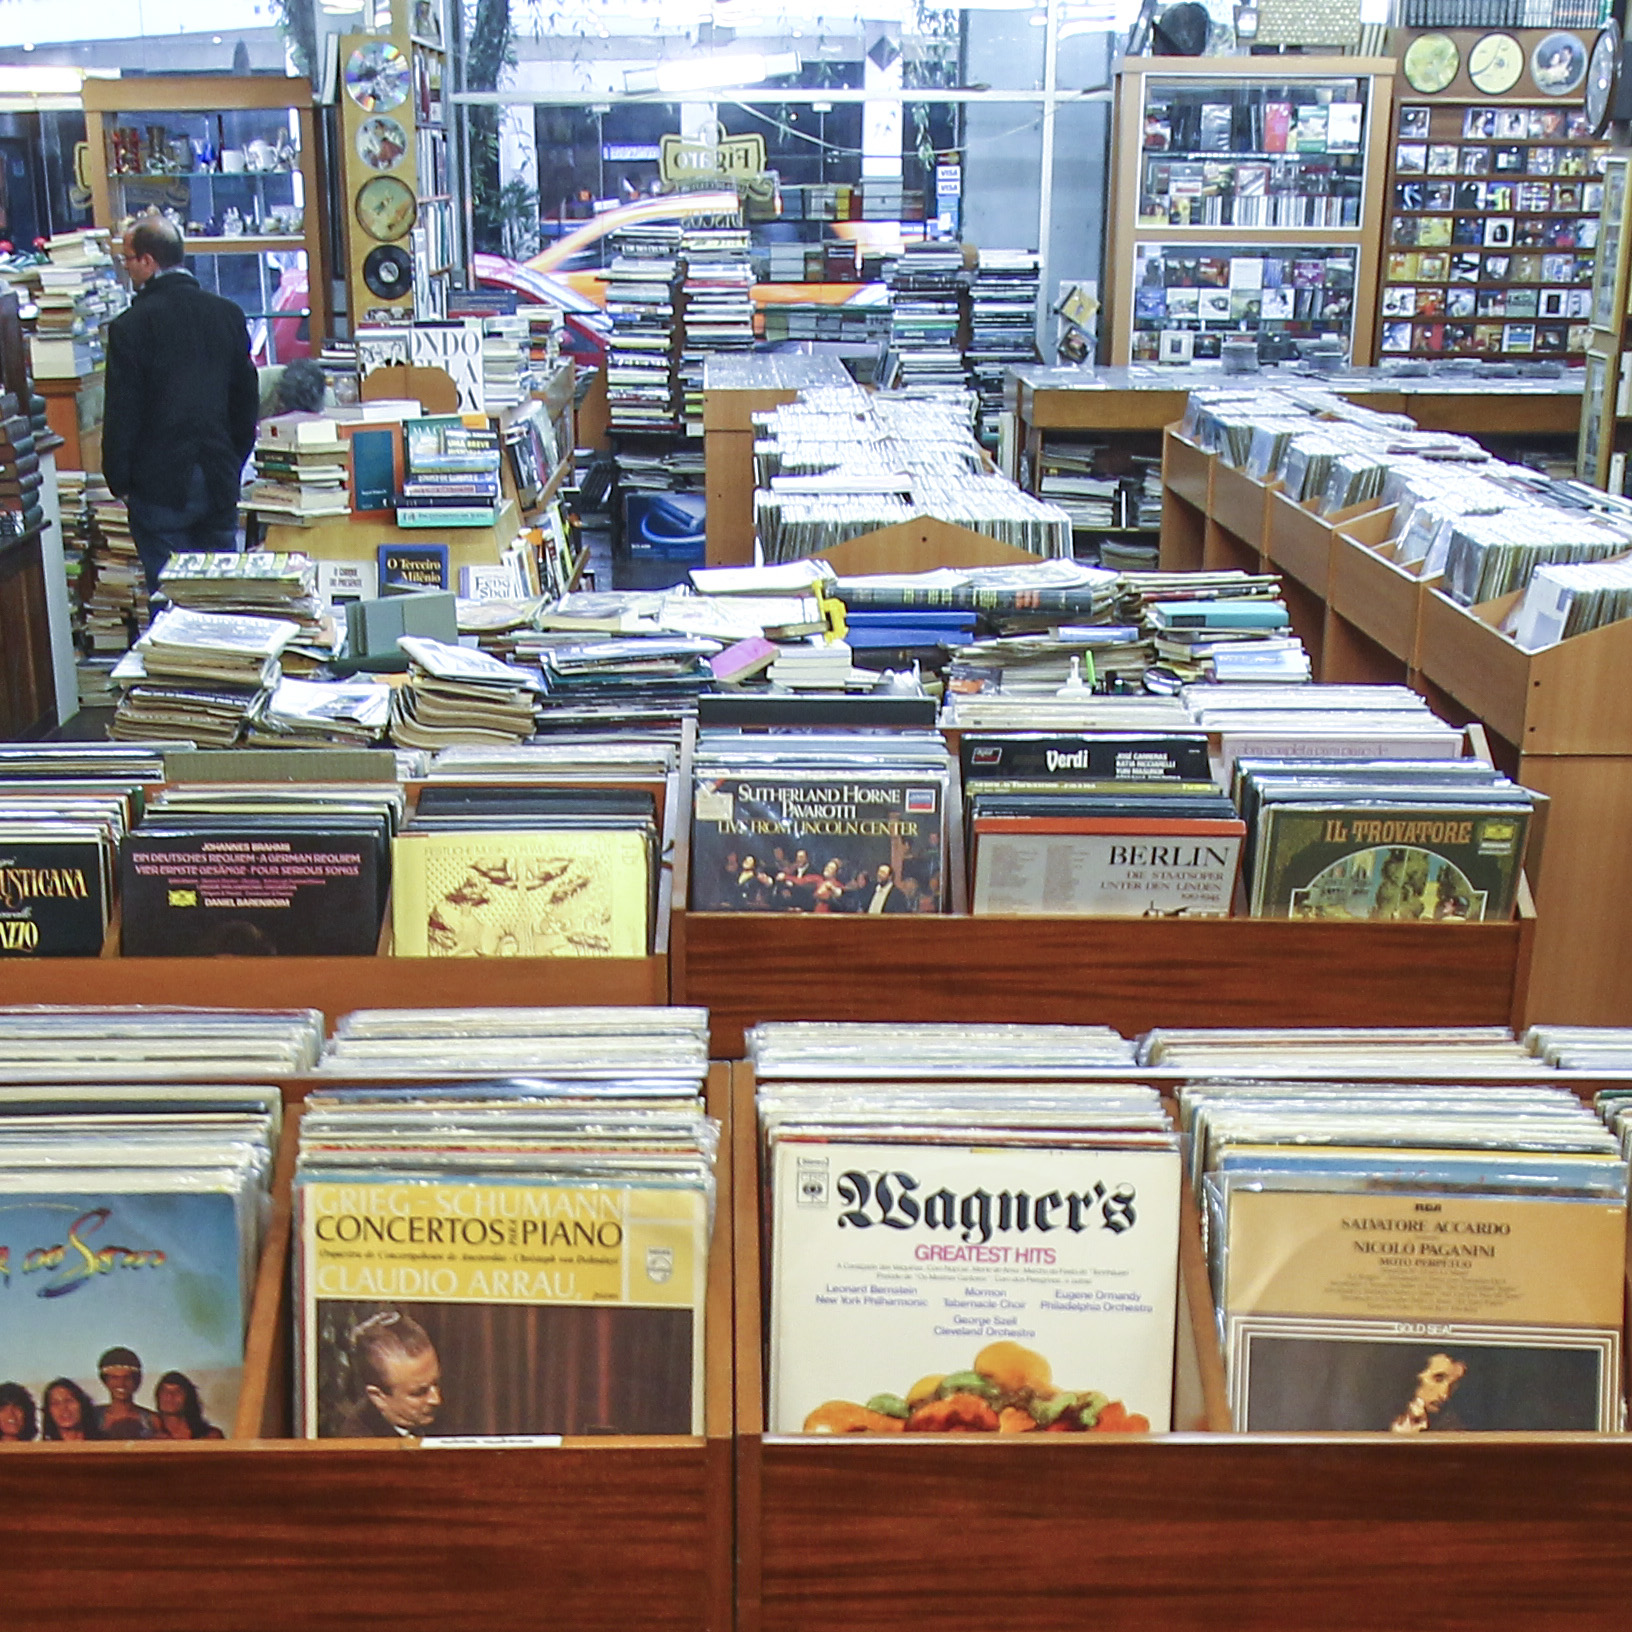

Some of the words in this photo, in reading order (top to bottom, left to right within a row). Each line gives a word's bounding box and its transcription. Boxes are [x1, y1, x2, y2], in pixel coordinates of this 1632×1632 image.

[387, 559, 398, 569] O
[1046, 750, 1089, 772] Verdi
[738, 783, 840, 802] SUTHERLAND
[843, 784, 900, 804] HORNE
[782, 802, 856, 819] PAVAROTTI
[751, 821, 790, 835] FROM
[861, 821, 917, 836] CENTER
[1325, 820, 1348, 842] IL
[1352, 820, 1472, 843] TROVATORE
[133, 853, 149, 863] EIN
[151, 853, 207, 863] DEUTSCHES
[209, 853, 255, 863] REQUIEM
[260, 853, 267, 863] A
[269, 853, 311, 863] GERMAN
[312, 853, 361, 863] REQUIEM
[1109, 846, 1230, 866] BERLIN
[1127, 872, 1144, 880] DIE
[1152, 872, 1224, 881] STAATSOPER
[1100, 882, 1141, 891] UNTER
[1146, 882, 1169, 891] DEN
[1177, 882, 1222, 891] LINDEN
[205, 899, 235, 907] DANIEL
[237, 899, 290, 907] BARENBOIM
[315, 1188, 411, 1216] GRIEG
[433, 1190, 622, 1219] SCHUMANN
[837, 1169, 1136, 1245] Wagner's
[1415, 1203, 1442, 1212] RCA
[315, 1215, 505, 1244] CONCERTOS
[523, 1221, 623, 1248] PIANO
[1342, 1218, 1424, 1231] SALVATORE
[1435, 1220, 1510, 1235] ACCARDO
[914, 1245, 1013, 1264] GREATEST
[1016, 1247, 1056, 1264] HITS
[1420, 1243, 1495, 1257] PAGANINI
[1380, 1257, 1411, 1266] MOTO
[1415, 1258, 1472, 1269] PERPETUO
[316, 1266, 459, 1295] CLAUDIO
[469, 1269, 583, 1299] ARRAU,
[826, 1285, 868, 1296] Leonard
[870, 1285, 918, 1296] Bernstein
[965, 1288, 1007, 1297] Mormon
[1055, 1290, 1093, 1301] Eugene
[1096, 1291, 1141, 1303] Ormandy
[816, 1296, 835, 1305] New
[837, 1296, 860, 1305] York
[863, 1296, 928, 1307] Philharmonic
[943, 1299, 996, 1309] Tabernacle
[998, 1300, 1026, 1310] Choir
[1040, 1301, 1100, 1313] Philadelphia
[1102, 1303, 1153, 1314] Orchestra
[953, 1316, 990, 1327] George
[993, 1316, 1018, 1326] Szell
[934, 1326, 984, 1337] Cleveland
[986, 1327, 1035, 1338] Orchestra
[1396, 1324, 1424, 1334] GOLD
